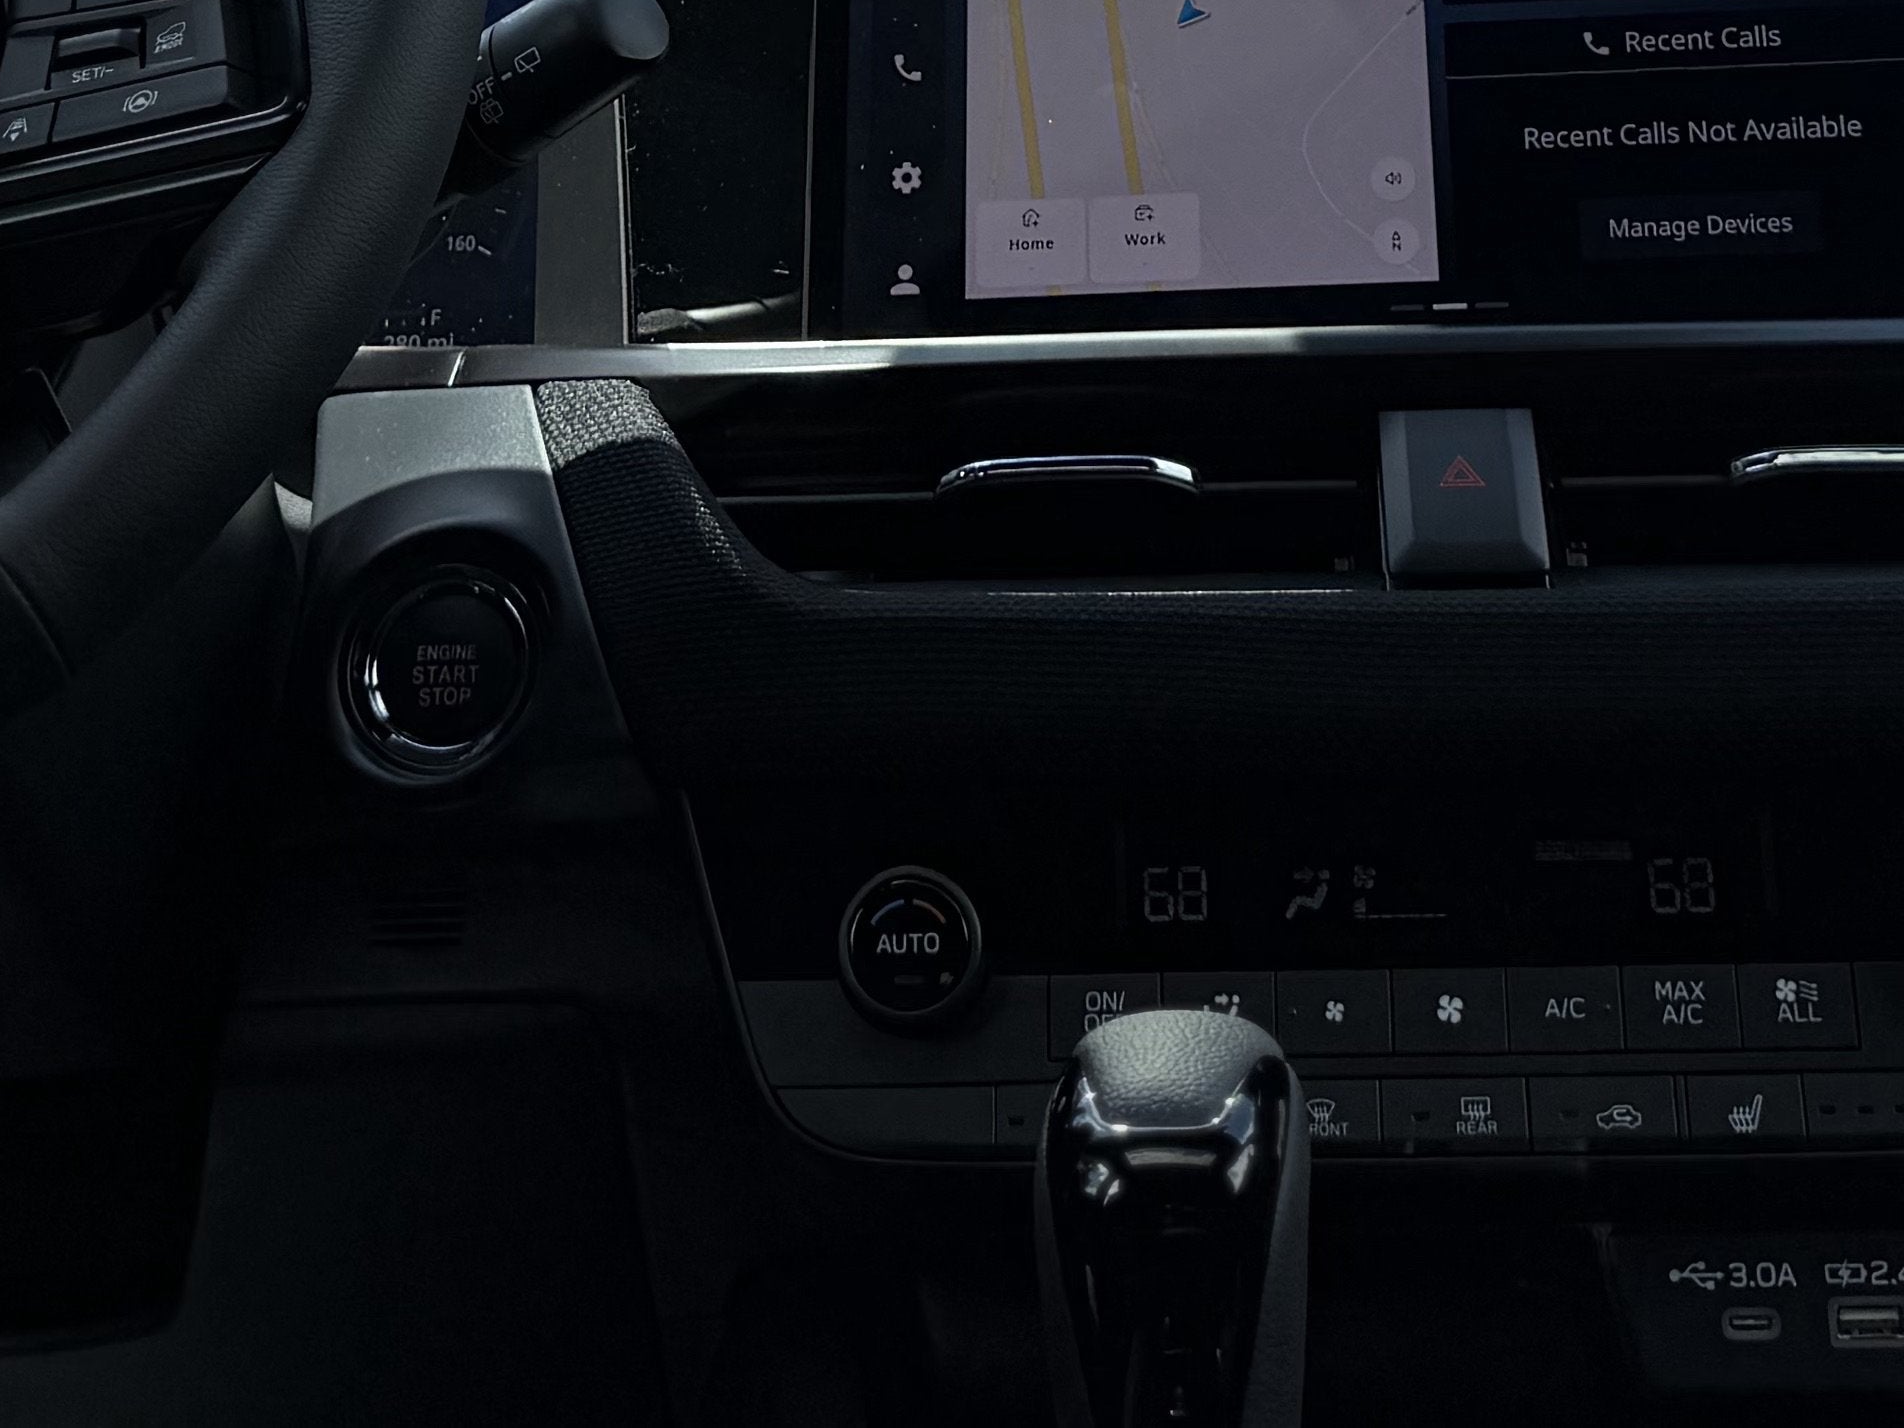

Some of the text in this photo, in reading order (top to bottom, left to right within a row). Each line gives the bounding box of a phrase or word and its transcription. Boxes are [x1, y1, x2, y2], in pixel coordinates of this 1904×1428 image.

[1623, 23, 1783, 54] Recent Calls
[467, 75, 495, 107] OFF
[1523, 114, 1864, 151] Recent Calls Not Available
[1123, 229, 1166, 248] Work
[1607, 212, 1794, 243] Manage Devices
[446, 234, 477, 253] 160
[1008, 234, 1055, 251] Home
[430, 308, 442, 327] F
[428, 331, 454, 347] mi
[415, 643, 479, 663] ENGINE
[411, 664, 480, 686] START
[418, 687, 472, 708] STOP
[1142, 864, 1210, 923] 68
[1646, 856, 1719, 916] 68
[875, 932, 941, 956] AUTO
[1084, 989, 1126, 1012] ON/
[1654, 980, 1707, 1003] MAX
[1544, 997, 1587, 1021] A/C
[1661, 1003, 1705, 1027] A/C
[1776, 1001, 1824, 1025] ALL
[1309, 1122, 1350, 1137] RONT
[1454, 1119, 1500, 1136] REAR
[1729, 1261, 1798, 1289] 3.0A
